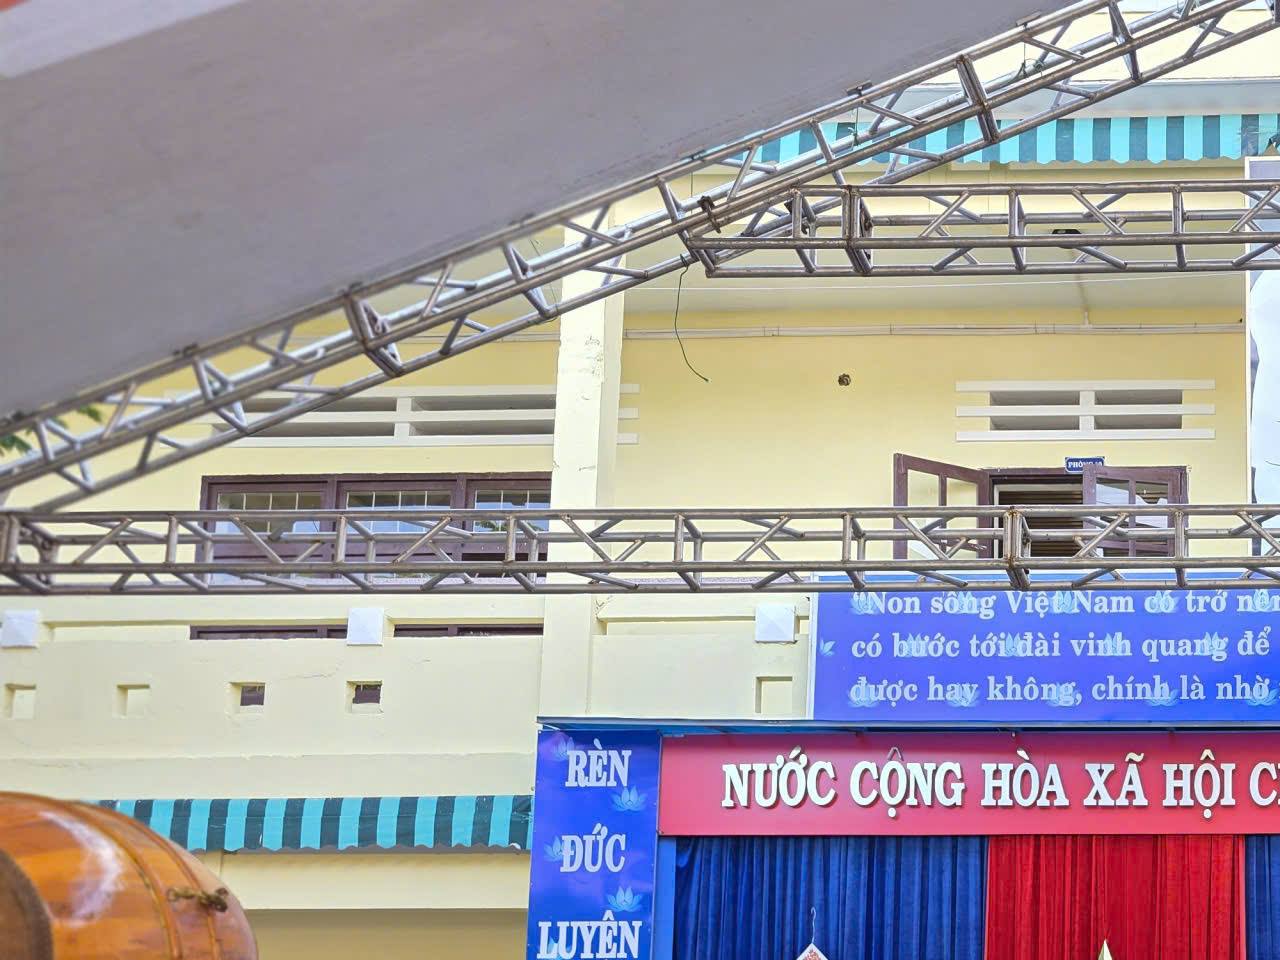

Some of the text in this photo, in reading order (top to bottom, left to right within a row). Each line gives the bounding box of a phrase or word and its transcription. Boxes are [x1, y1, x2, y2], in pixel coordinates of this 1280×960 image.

[931, 591, 996, 619] sông
[1005, 591, 1062, 618] Việt
[1073, 591, 1134, 613] Nam
[1144, 591, 1174, 613] có
[852, 633, 882, 657] có
[892, 633, 960, 657] bước
[970, 632, 1006, 657] tới
[1018, 632, 1061, 657] đài
[1070, 631, 1132, 656] vinh
[1142, 638, 1228, 662] quang
[1237, 626, 1271, 655] để
[850, 676, 918, 707] được
[928, 676, 978, 705] hay
[987, 676, 1082, 706] không,
[1091, 675, 1170, 700] chính
[1180, 675, 1206, 700] là
[1216, 675, 1270, 700] nhờ
[565, 738, 631, 788] RÈN
[722, 746, 837, 808] NƯỚC
[850, 747, 965, 818] CỘNG
[980, 748, 1069, 807] HÒA
[1084, 752, 1148, 806] XÃ
[1162, 750, 1236, 818] HỘI
[560, 823, 626, 873] ĐỨC
